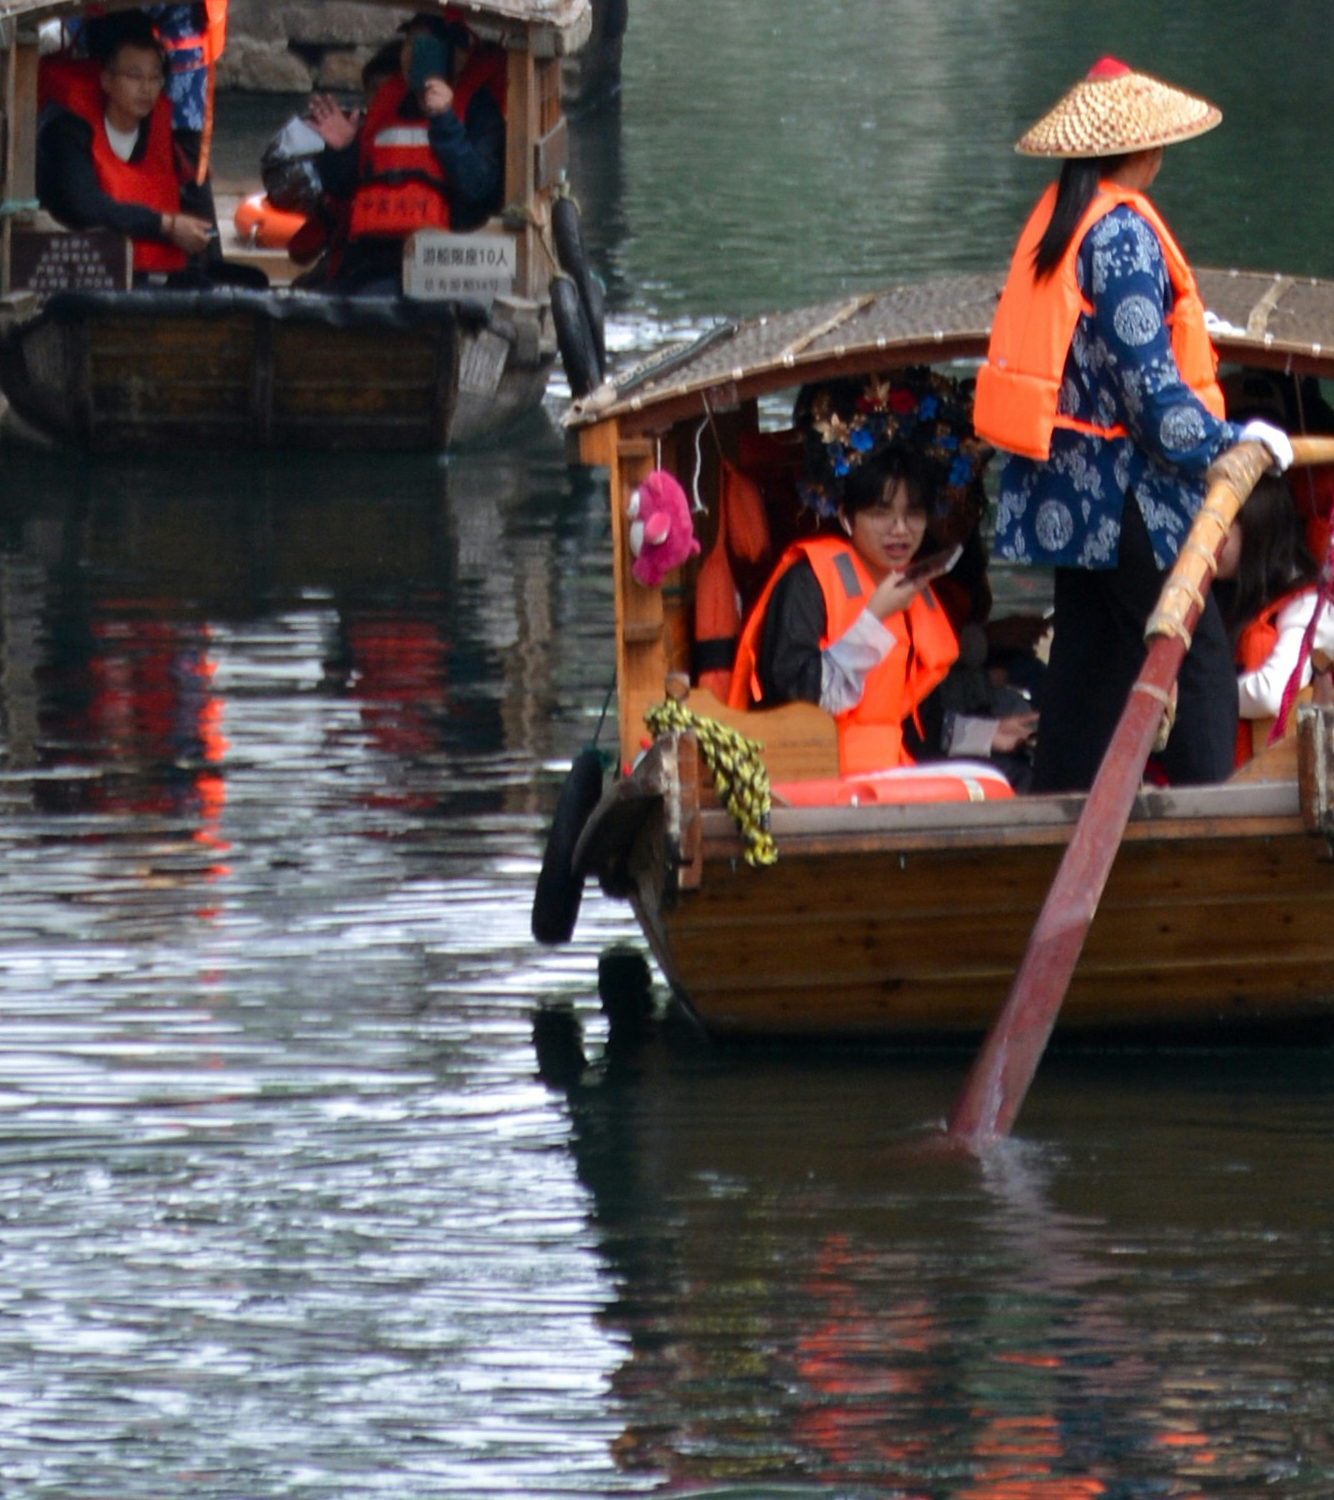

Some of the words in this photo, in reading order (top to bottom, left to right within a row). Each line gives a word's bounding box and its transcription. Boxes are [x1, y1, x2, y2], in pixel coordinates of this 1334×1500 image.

[423, 247, 508, 266] 游船限座10人
